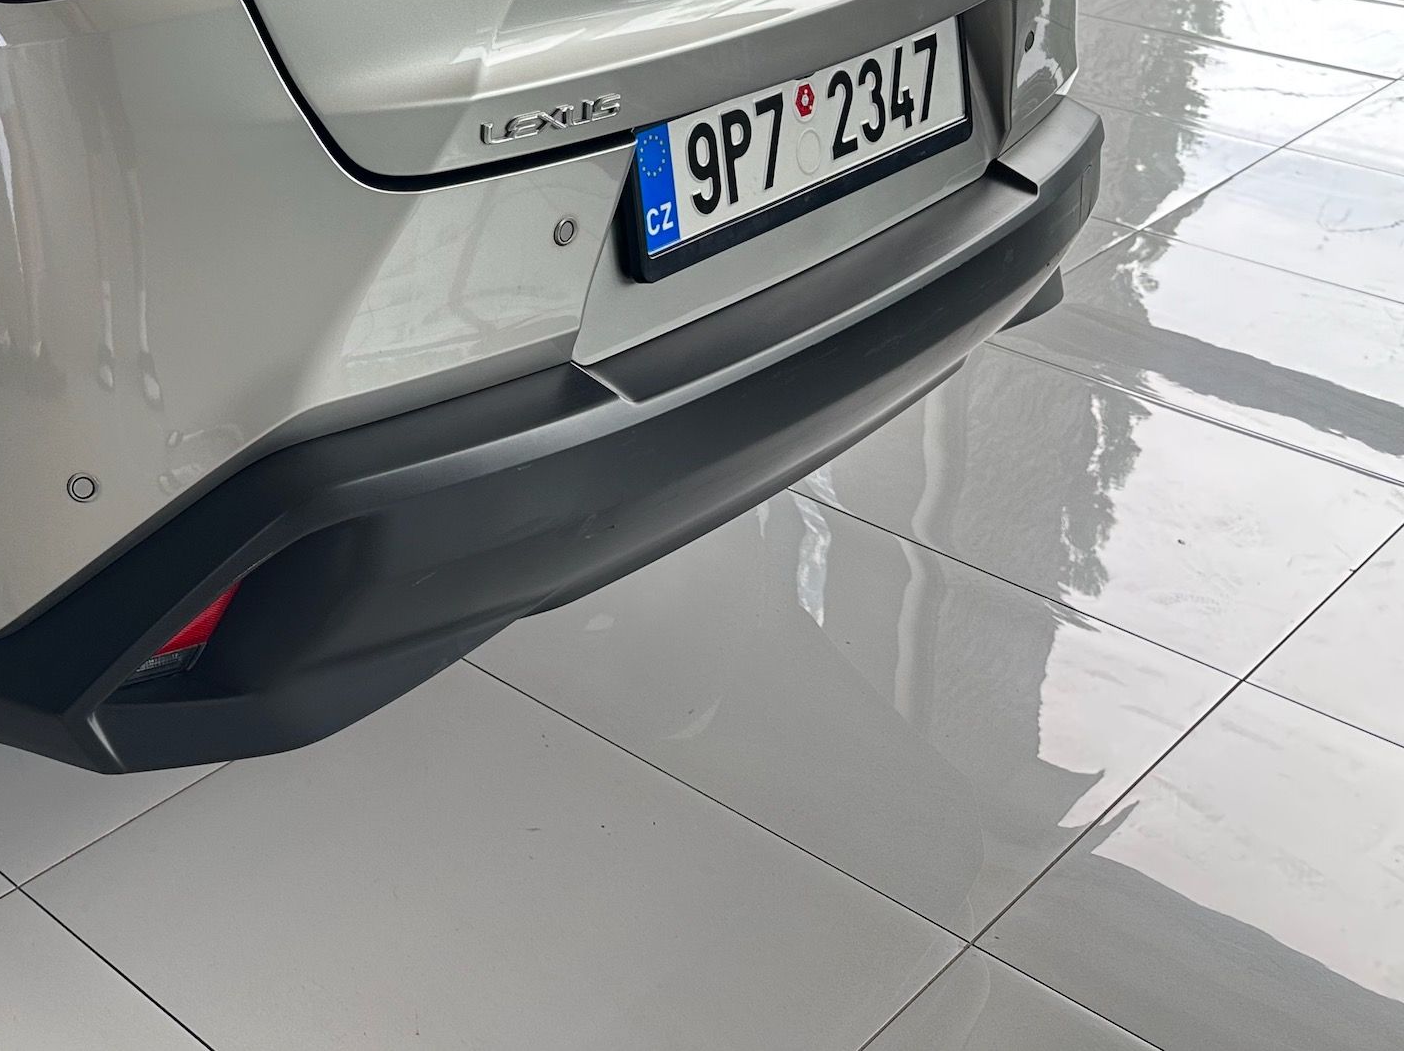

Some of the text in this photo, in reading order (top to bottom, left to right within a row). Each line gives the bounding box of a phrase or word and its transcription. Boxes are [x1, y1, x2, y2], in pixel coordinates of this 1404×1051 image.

[480, 92, 622, 145] LEXUS
[686, 30, 938, 216] 9P7 2347
[646, 201, 674, 237] CZ
